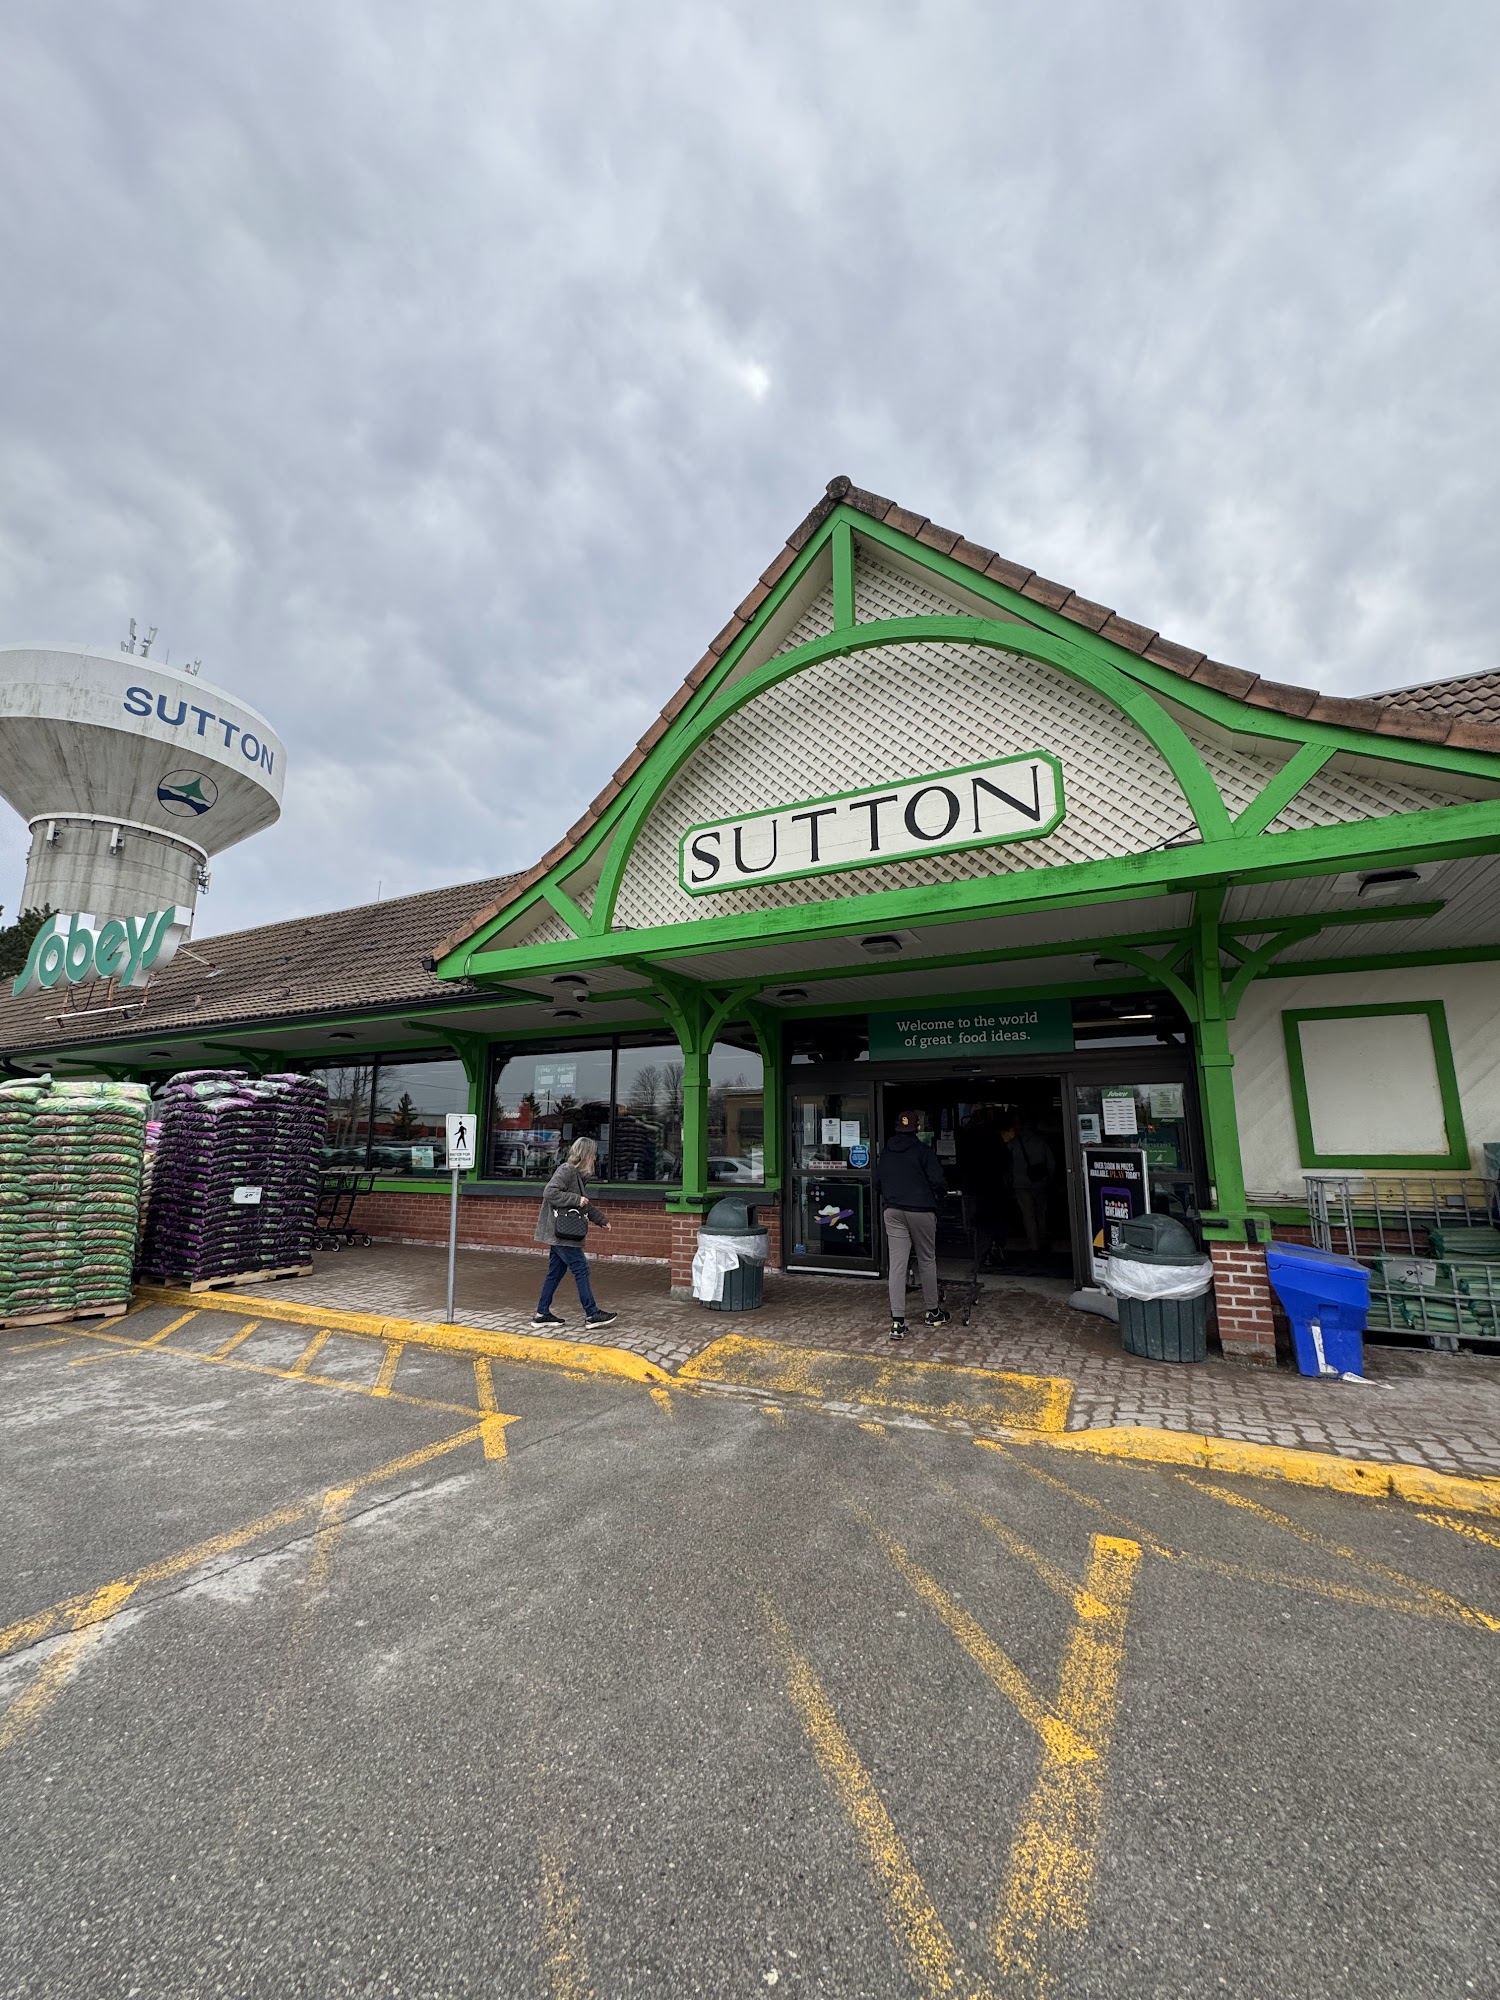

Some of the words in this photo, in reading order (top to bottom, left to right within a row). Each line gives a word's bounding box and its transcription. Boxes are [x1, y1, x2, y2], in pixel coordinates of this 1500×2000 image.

[123, 686, 275, 776] SUTTON
[690, 764, 1041, 884] SUTTON
[12, 905, 179, 997] Sobeys
[896, 1020, 955, 1032] Welcome
[957, 1018, 971, 1029] to
[974, 1015, 995, 1027] the
[999, 1011, 1039, 1026] world
[904, 1034, 918, 1047] of
[919, 1034, 952, 1049] great
[958, 1031, 988, 1044] food
[991, 1029, 1031, 1042] ideas.
